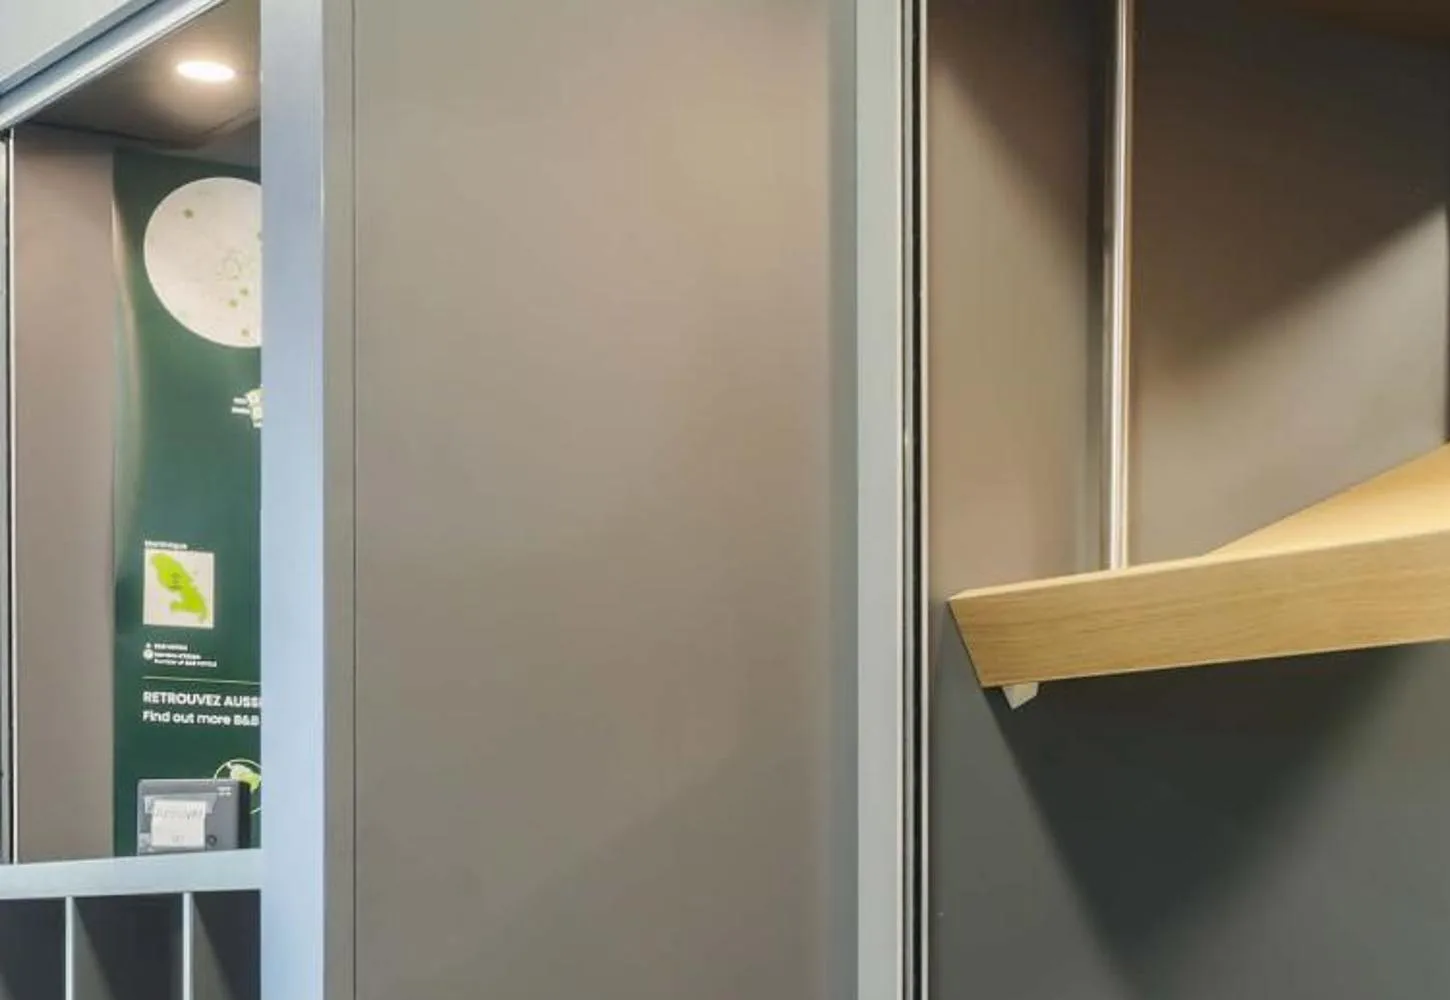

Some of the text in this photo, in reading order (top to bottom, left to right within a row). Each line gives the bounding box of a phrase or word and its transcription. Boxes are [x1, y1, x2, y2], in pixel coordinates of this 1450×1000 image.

[143, 691, 221, 706] RETROUVEZ
[143, 710, 170, 722] Find
[172, 713, 195, 724] out
[196, 714, 231, 725] more
